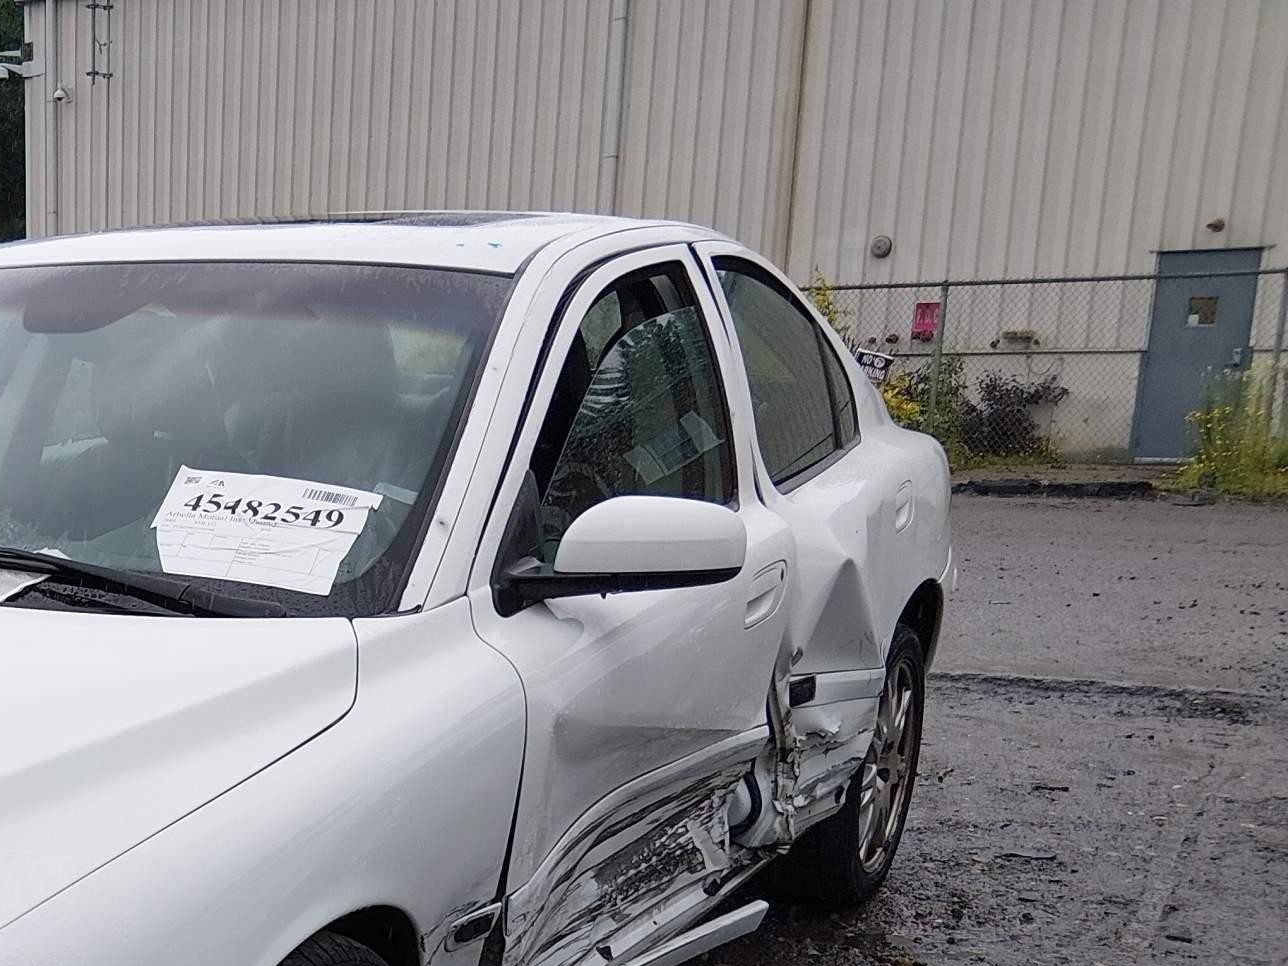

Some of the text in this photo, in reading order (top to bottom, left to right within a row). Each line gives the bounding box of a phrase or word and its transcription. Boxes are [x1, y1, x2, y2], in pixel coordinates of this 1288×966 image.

[861, 354, 873, 365] NO
[862, 364, 885, 380] RKING
[184, 493, 345, 529] 45482549
